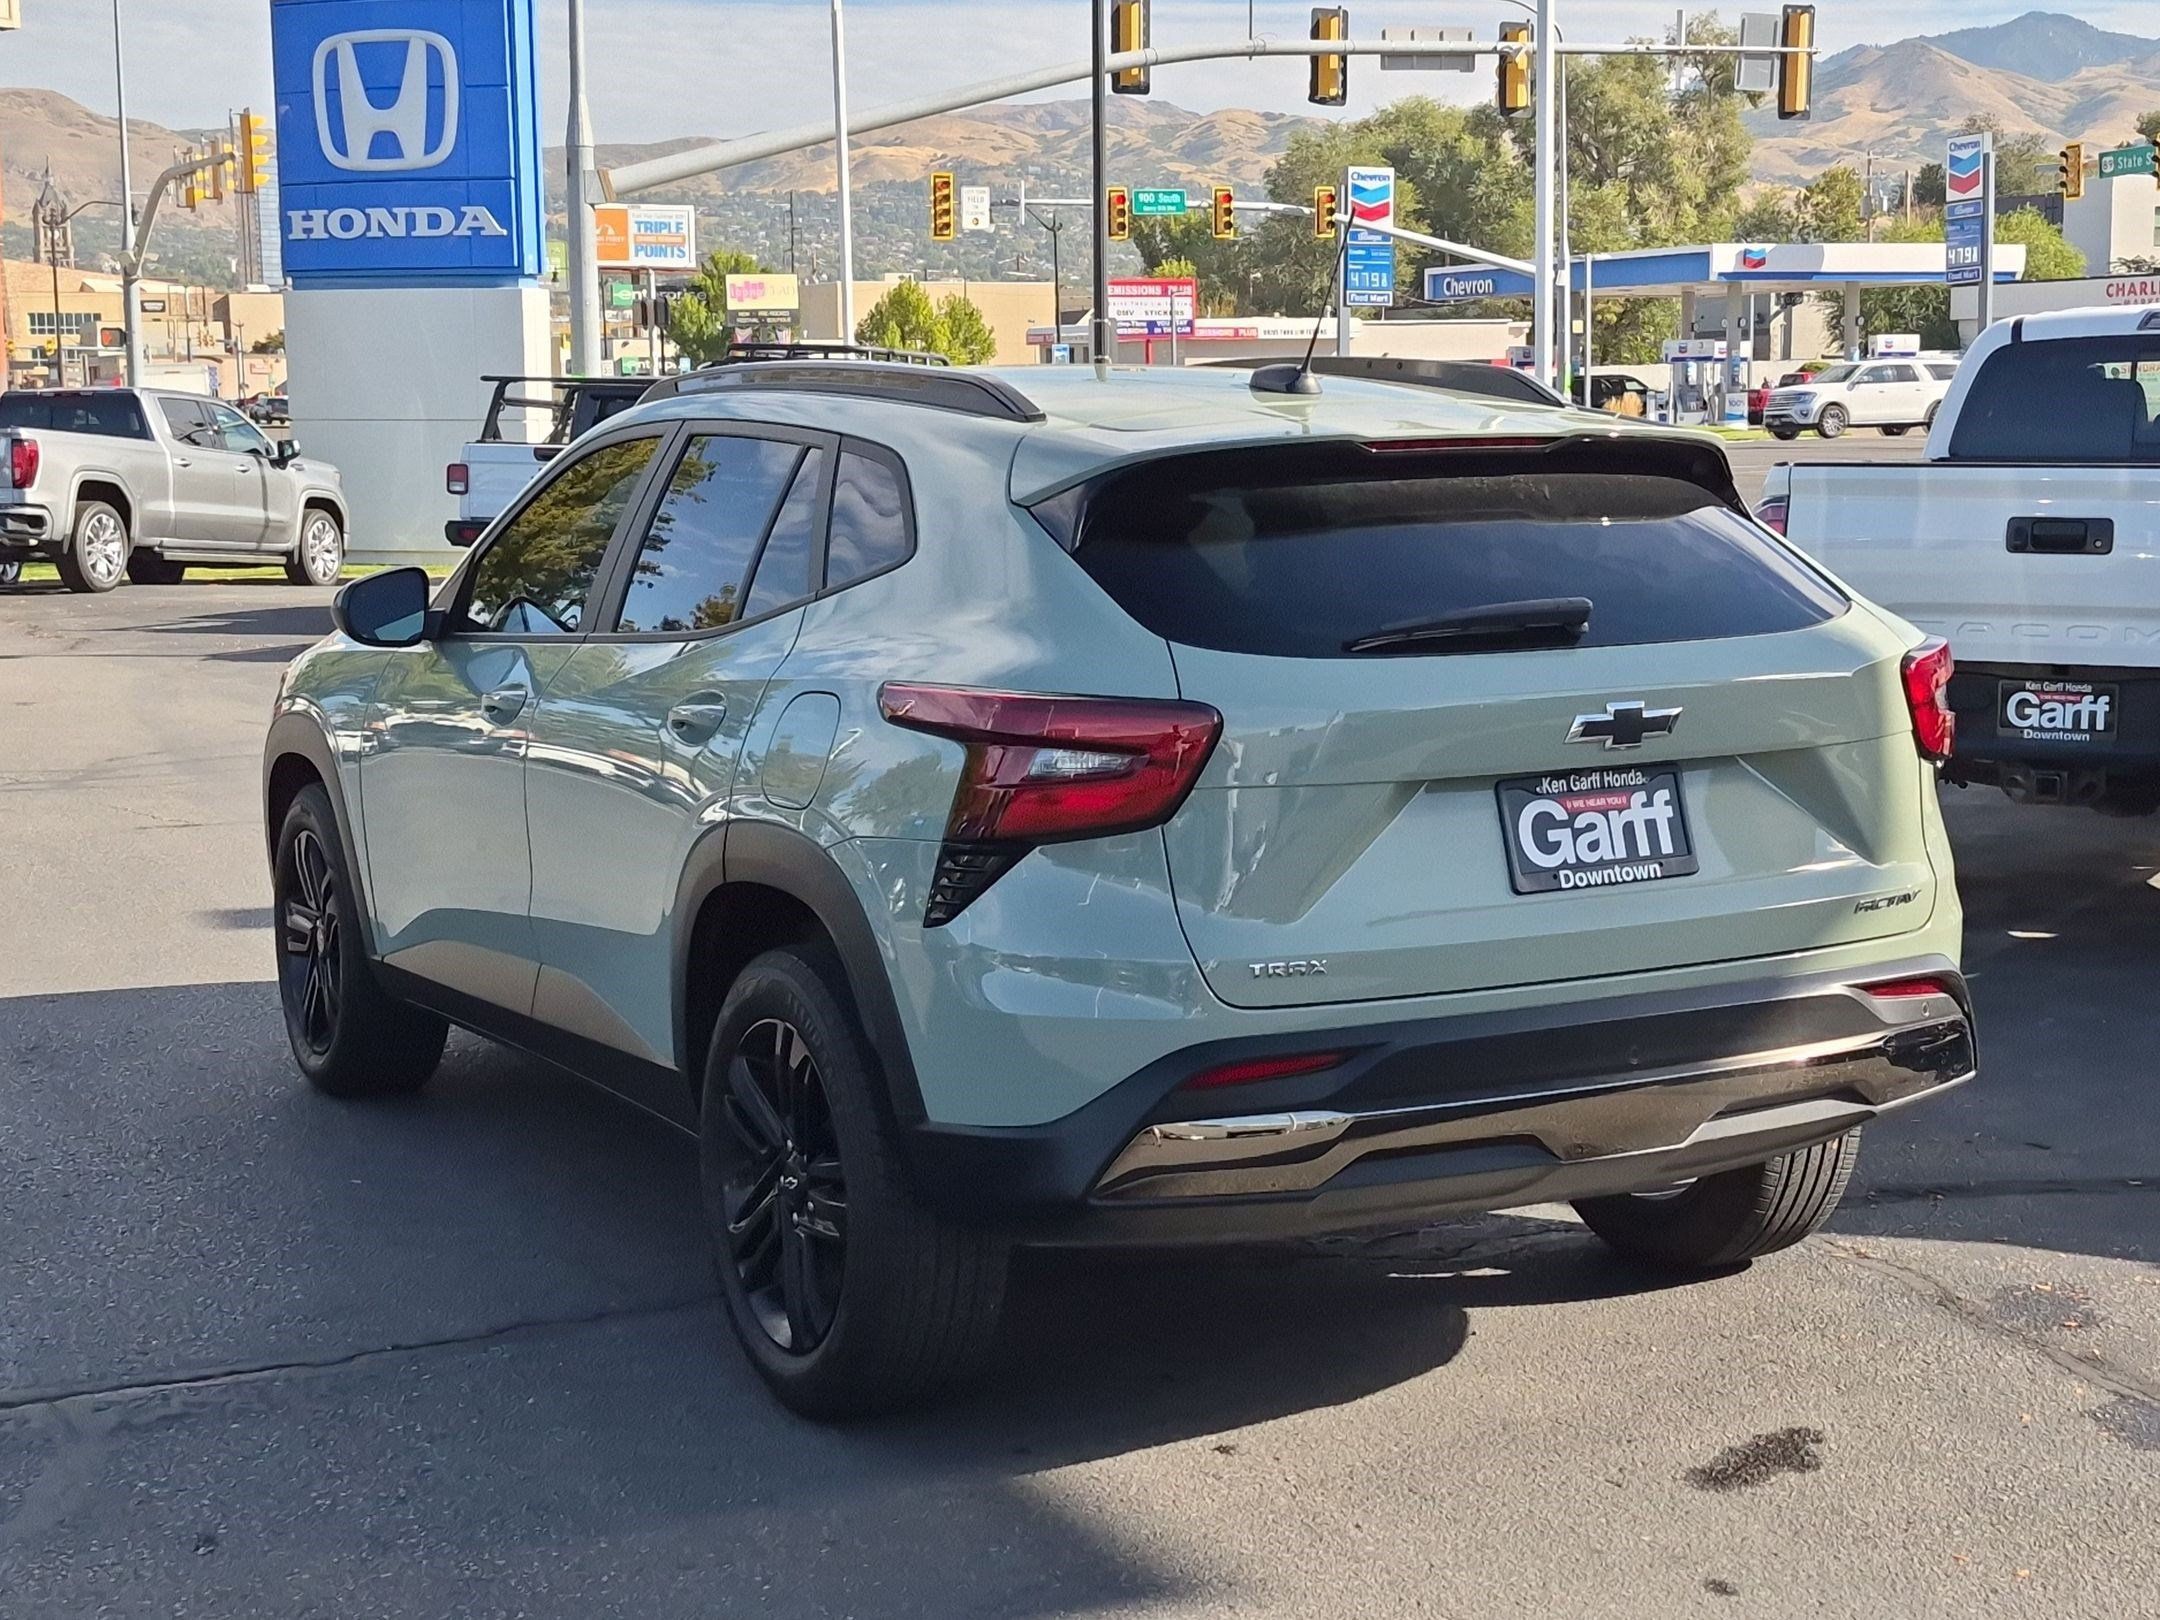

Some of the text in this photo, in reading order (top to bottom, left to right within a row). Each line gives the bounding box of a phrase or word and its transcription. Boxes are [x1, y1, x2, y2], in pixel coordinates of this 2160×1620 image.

[1949, 140, 1980, 151] Chevron
[2117, 155, 2143, 170] State
[1350, 171, 1390, 182] Chevron
[1138, 193, 1181, 204] 900 South
[287, 206, 508, 240] HONDA
[634, 221, 684, 233] TRIPLE
[634, 245, 687, 259] POINTS
[1107, 285, 1161, 295] EMISSIONS
[1443, 278, 1493, 297] Chevron
[1350, 293, 1388, 302] Food Mart
[2025, 681, 2092, 693] Ken Garff Honda
[2006, 691, 2110, 731] Garff
[2023, 729, 2090, 741] Downtown
[1541, 769, 1643, 794] Ken Garff Honda
[1608, 796, 1622, 805] YOU
[1518, 788, 1674, 868] Garff
[1558, 862, 1662, 888] Downtown
[1248, 959, 1328, 979] TRAX
